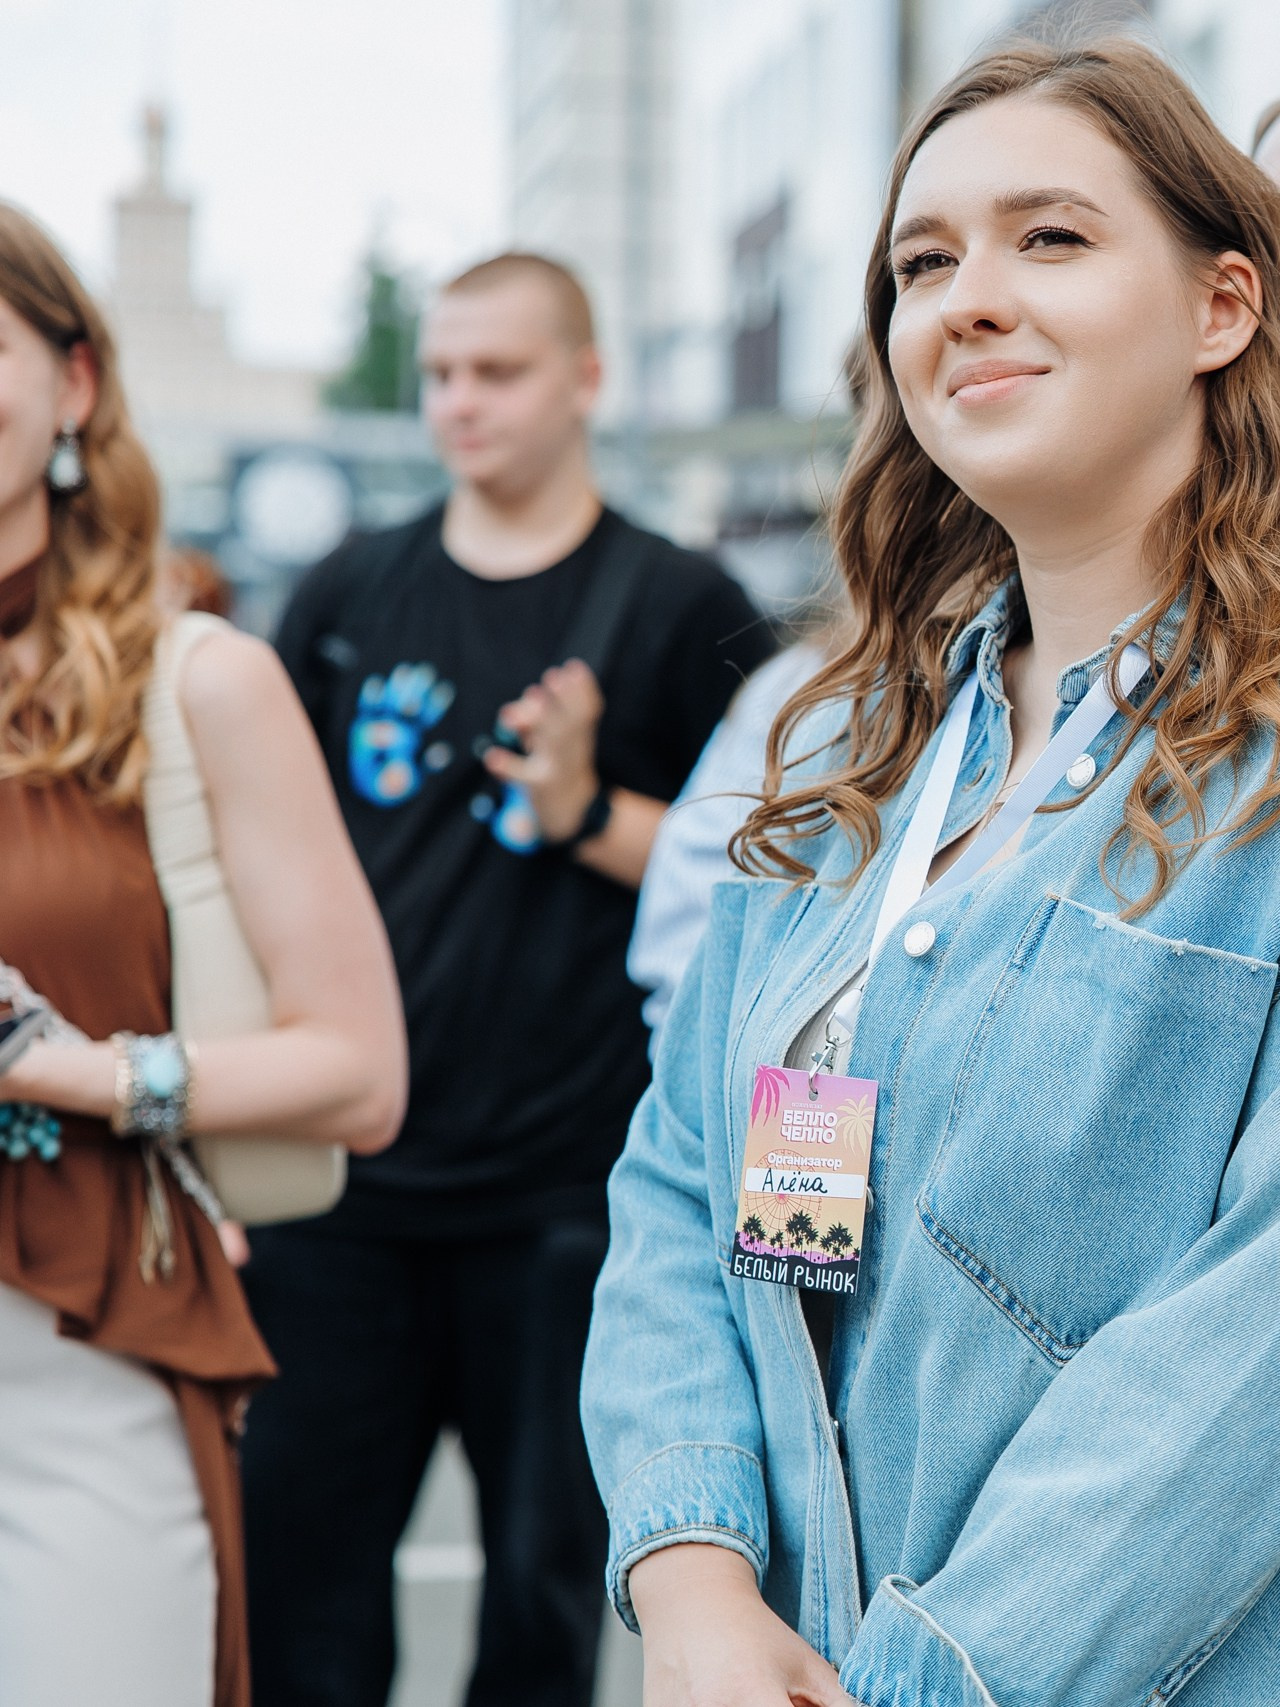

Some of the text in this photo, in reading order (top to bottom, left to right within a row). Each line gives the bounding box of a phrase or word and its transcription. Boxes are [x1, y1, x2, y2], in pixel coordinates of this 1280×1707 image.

[782, 1109, 838, 1128] БЕЛЛО
[780, 1125, 836, 1144] ЧЕЛЛО
[767, 1152, 842, 1171] Организатор
[762, 1167, 828, 1194] Алёна
[733, 1254, 856, 1294] БЕЛЫЙ РЫНОК
